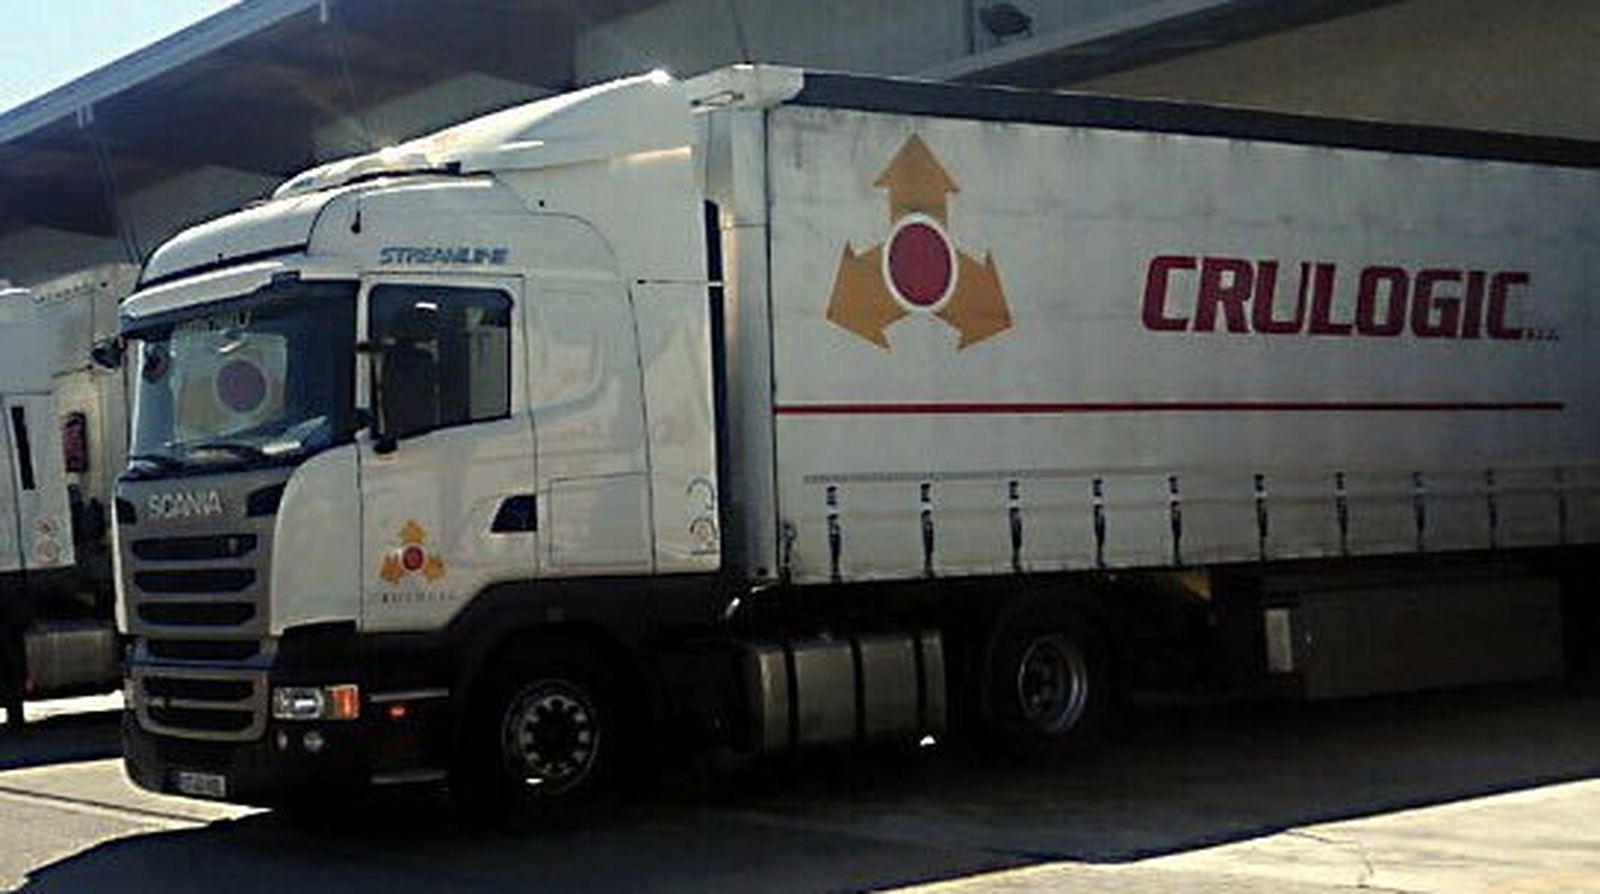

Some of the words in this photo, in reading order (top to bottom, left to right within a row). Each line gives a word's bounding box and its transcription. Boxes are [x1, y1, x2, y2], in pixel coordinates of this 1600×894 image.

[379, 246, 509, 265] STREAMLINE
[1141, 255, 1529, 340] CRULOGIC
[147, 491, 222, 518] SCANIA
